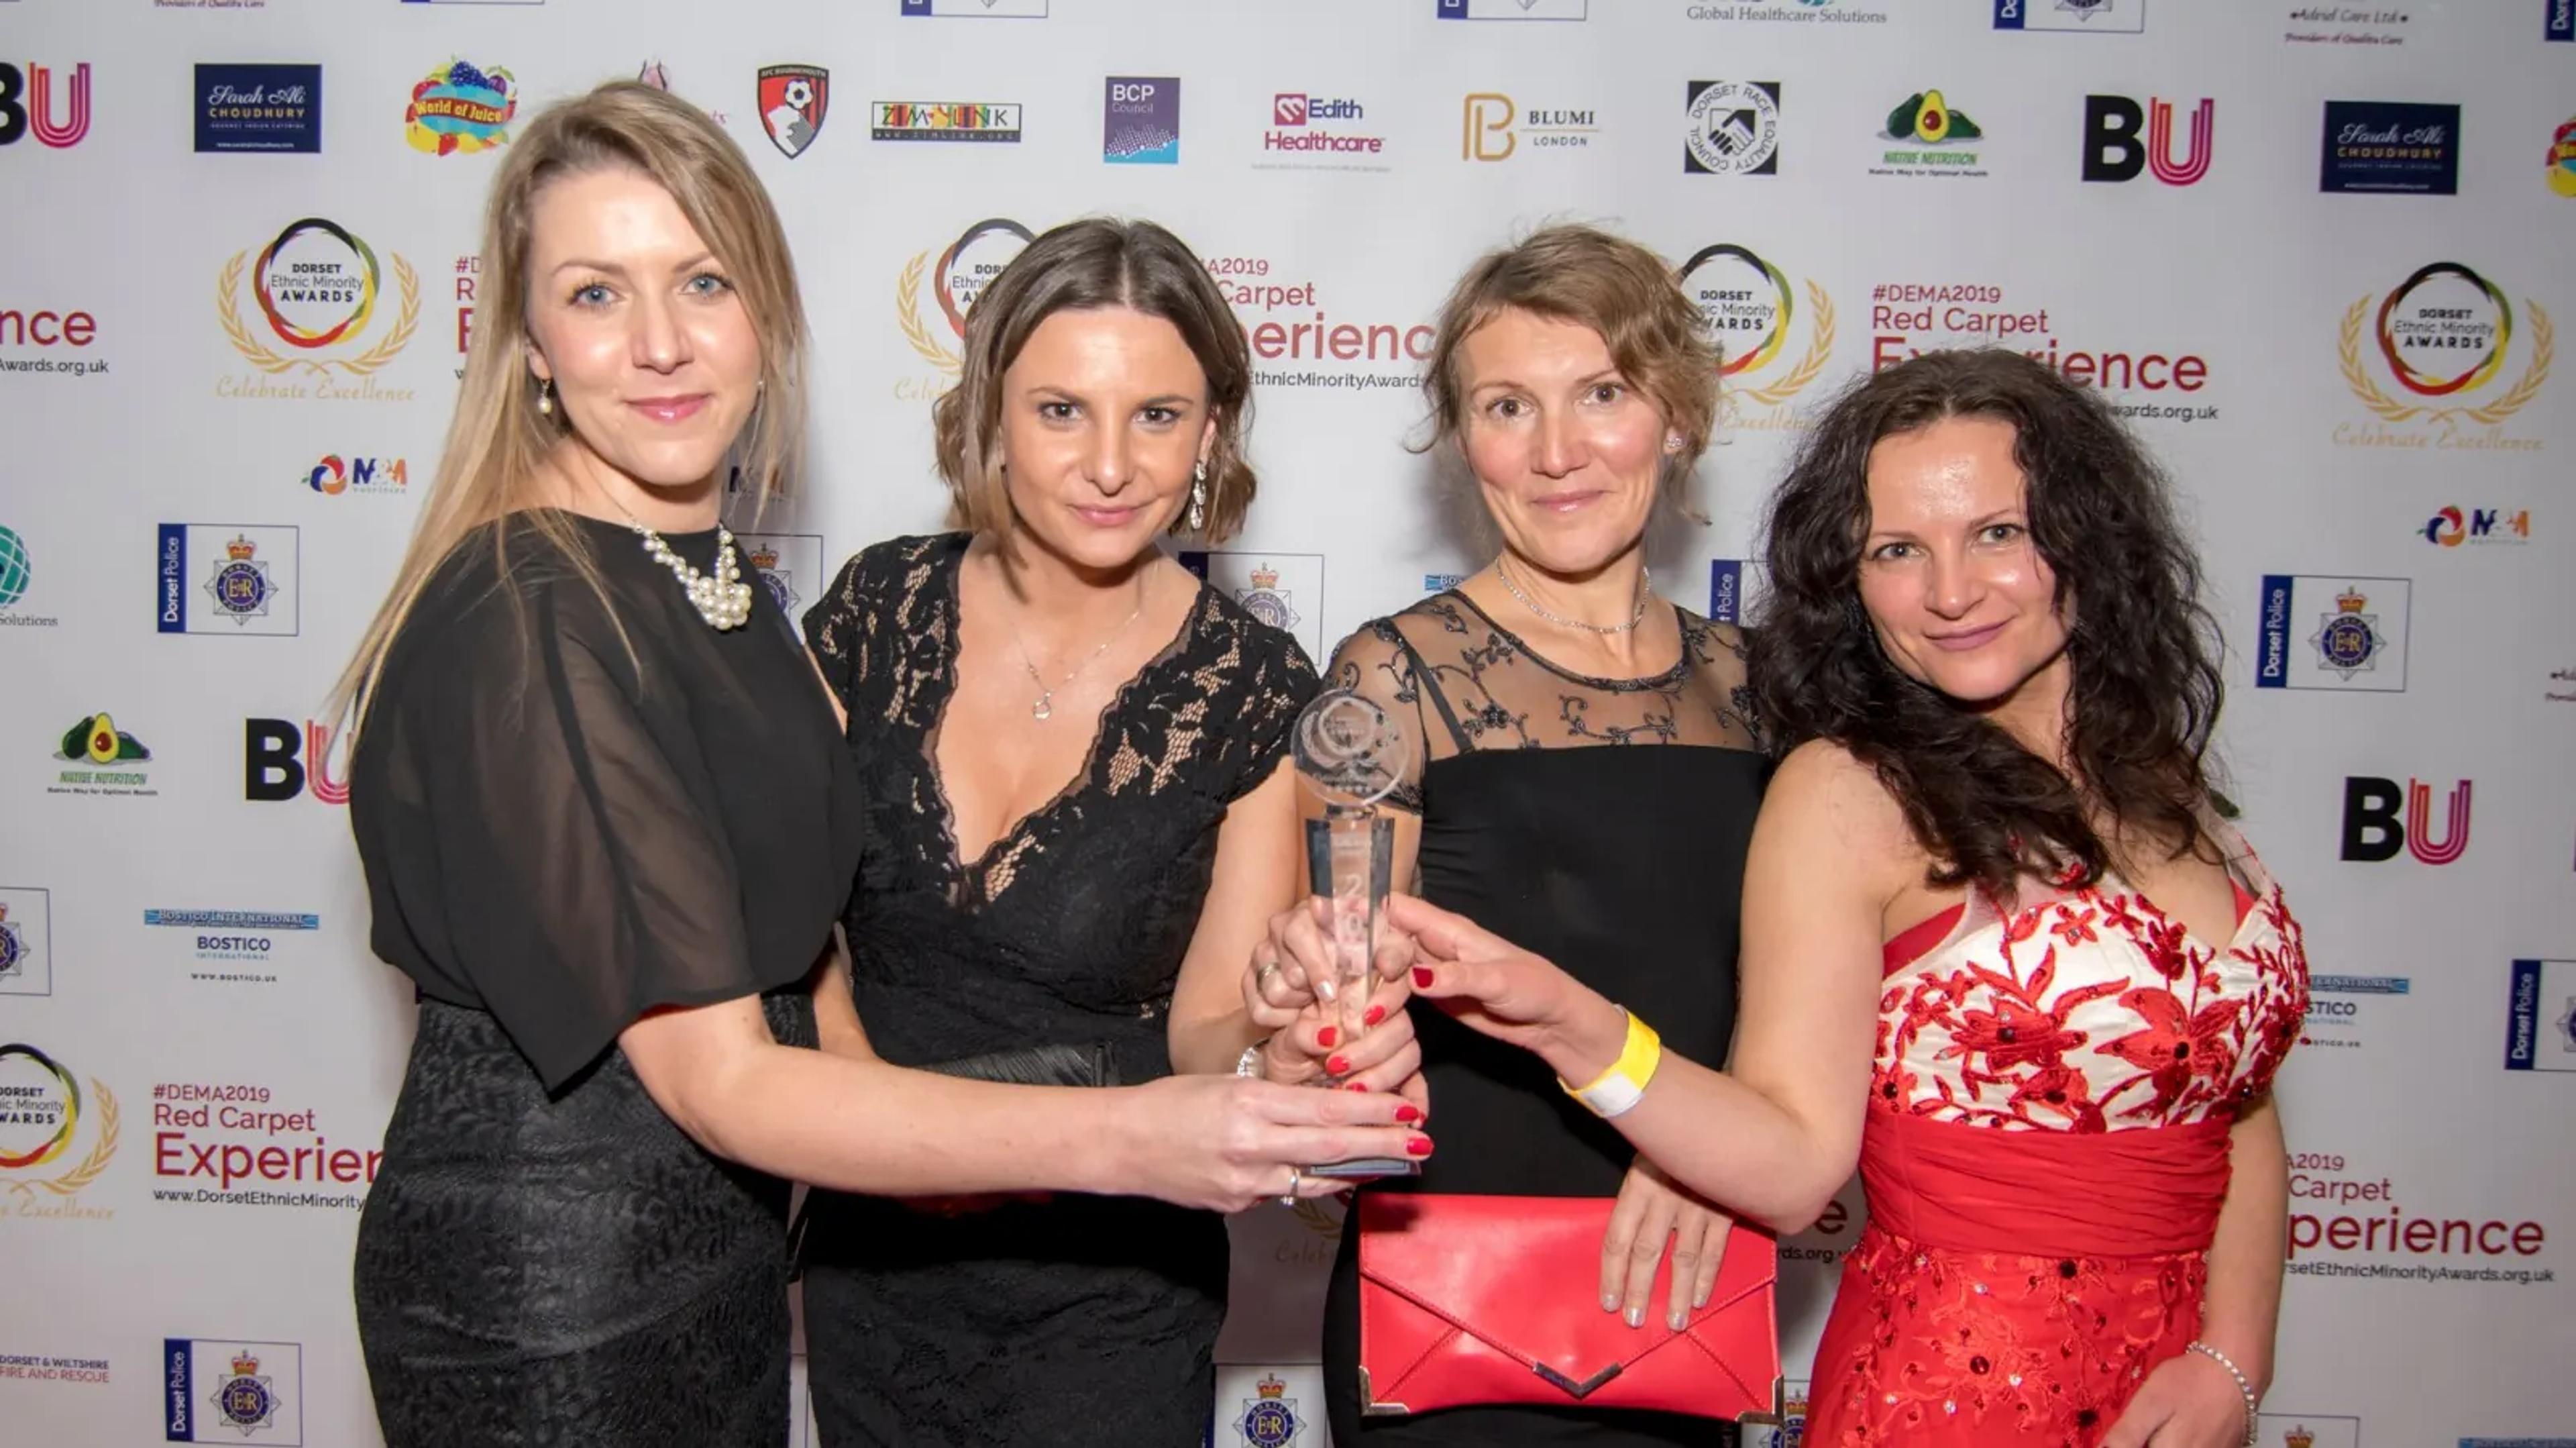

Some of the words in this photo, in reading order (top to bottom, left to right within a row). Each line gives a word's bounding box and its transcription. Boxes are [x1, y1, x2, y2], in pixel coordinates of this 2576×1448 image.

[1686, 5, 1734, 21] Global
[1739, 7, 1816, 23] Healthcare
[1819, 8, 1888, 24] Solutions
[208, 85, 264, 105] Sarah
[268, 85, 307, 105] Ali
[1114, 84, 1155, 101] BCP
[1691, 84, 1738, 119] DORSET
[1743, 87, 1773, 116] RACE
[209, 107, 306, 119] CHOUDHURY
[415, 101, 451, 115] World
[454, 104, 469, 117] of
[470, 106, 502, 122] Juice
[1112, 103, 1154, 114] Council
[1308, 99, 1364, 119] Edith
[1529, 110, 1595, 125] BLUMI
[1265, 131, 1383, 153] Healthcare
[1534, 137, 1589, 147] LONDON
[1690, 125, 1729, 170] COUNCIL
[1735, 120, 1776, 171] EQUALITY
[2081, 95, 2214, 187] BU
[2337, 147, 2443, 159] CHOUDHURY
[292, 263, 342, 274] DORSET
[975, 264, 1004, 275] DOR
[1207, 257, 1269, 276] A2019
[271, 274, 309, 289] Ethnic
[313, 275, 365, 291] Minority
[280, 290, 354, 303] AWARDS
[1217, 280, 1316, 311] Carpet
[1701, 290, 1753, 301] DORSET
[1872, 284, 2002, 304] #DEMA2019
[1722, 303, 1776, 320] Minority
[1872, 305, 1933, 331] Red
[1944, 307, 2049, 338] Carpet
[2418, 309, 2473, 320] DORSET
[0, 309, 97, 347] nce
[1708, 318, 1764, 329] ARDS
[2394, 319, 2436, 334] Ethnic
[2441, 321, 2495, 338] Minority
[1252, 311, 1437, 361] erienc
[2404, 336, 2484, 349] AWARDS
[216, 375, 308, 399] Celebrate
[316, 376, 417, 401] Excellence
[164, 536, 179, 577] Police
[163, 578, 179, 623] Dorset
[1717, 573, 1734, 613] Police
[2266, 588, 2286, 629] Police
[2263, 631, 2282, 678] Dorset
[245, 717, 353, 805] BU
[2340, 776, 2472, 865] BU
[197, 936, 271, 951] BOSTICO
[2515, 972, 2534, 1013] Police
[2306, 1001, 2357, 1016] STICO
[2511, 1015, 2530, 1059] Dorset
[154, 1084, 271, 1104] #DEMA2019
[17, 1098, 64, 1115] Minority
[0, 1113, 56, 1124] WARDS
[154, 1104, 209, 1128] Red
[219, 1106, 316, 1135] Carpet
[156, 1132, 383, 1190] Experie
[2289, 1174, 2392, 1206] Carpet
[154, 1189, 365, 1212] www.DorsetEthnicMinority
[2286, 1207, 2545, 1260] perience
[0, 1355, 41, 1366] DORSET
[52, 1357, 109, 1369] WILTSHIRE
[170, 1351, 186, 1388] Police
[0, 1365, 25, 1378] FIRE
[28, 1367, 58, 1380] AND
[60, 1369, 109, 1383] RESCUE
[171, 1390, 186, 1433] Dorset
